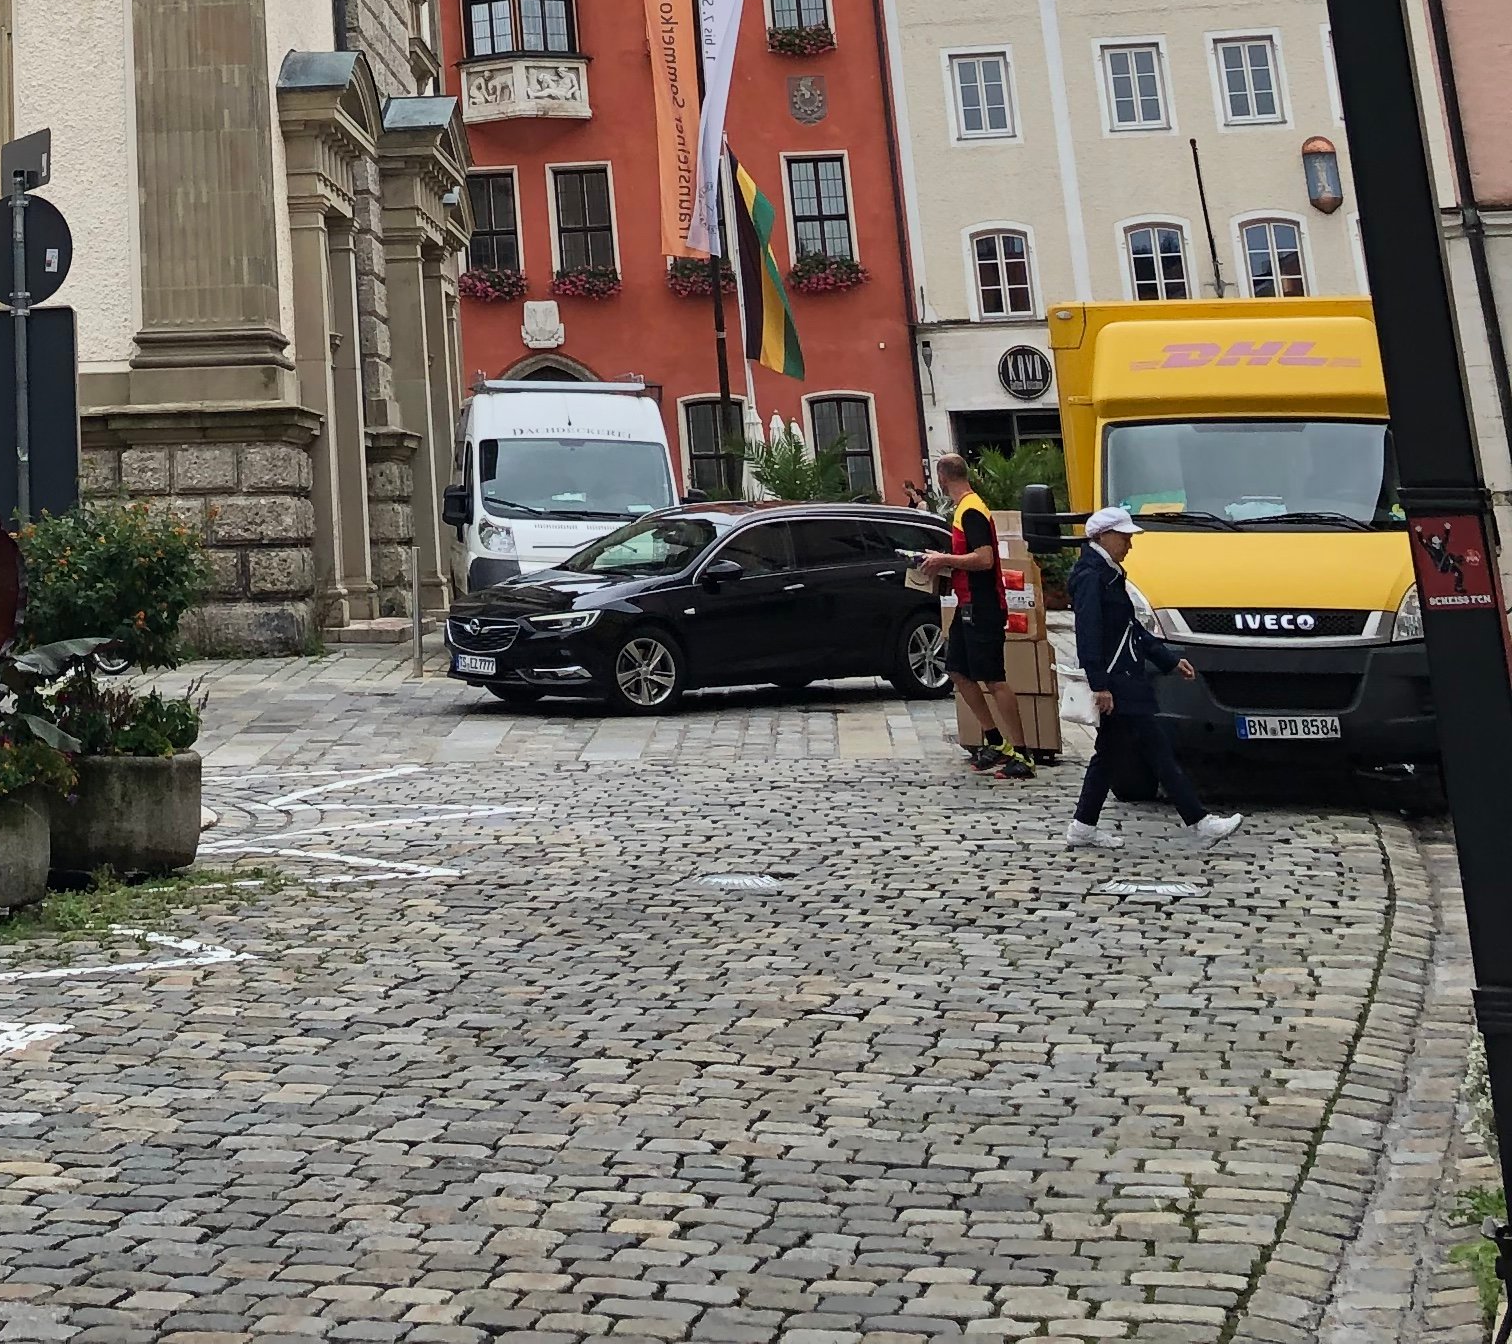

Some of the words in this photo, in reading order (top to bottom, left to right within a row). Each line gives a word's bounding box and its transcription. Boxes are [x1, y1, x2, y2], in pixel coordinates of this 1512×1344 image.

[1161, 341, 1328, 369] DHL
[1234, 614, 1315, 630] IVECO
[1248, 719, 1268, 736] BN
[1278, 719, 1299, 736] PD
[1302, 719, 1338, 736] 8584
